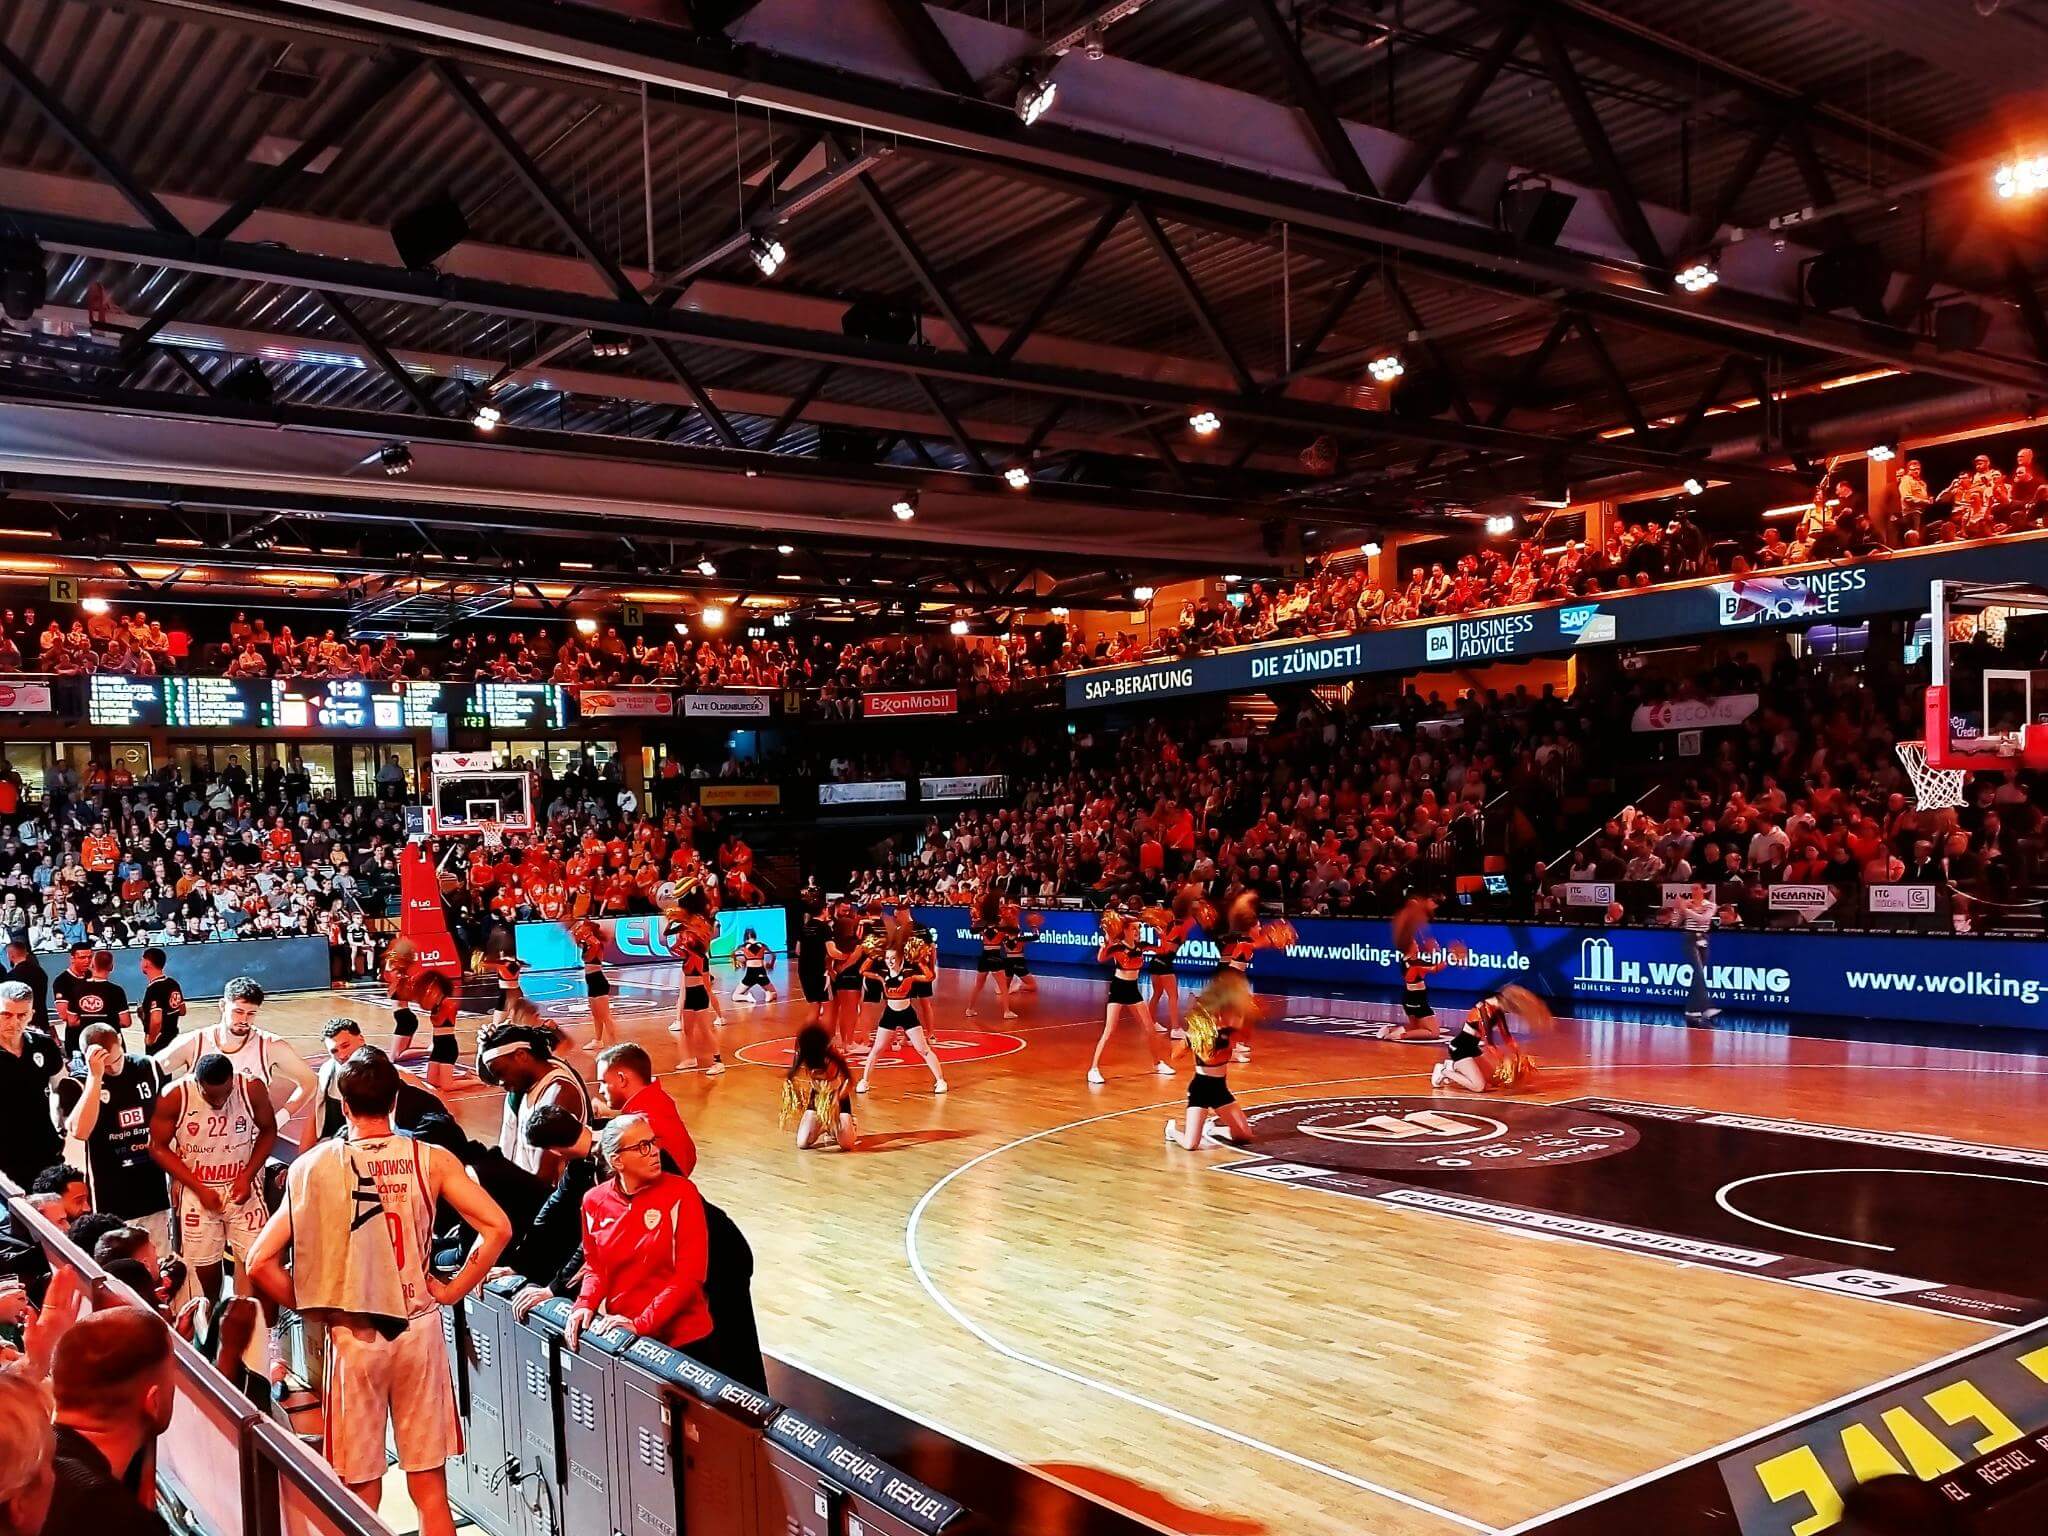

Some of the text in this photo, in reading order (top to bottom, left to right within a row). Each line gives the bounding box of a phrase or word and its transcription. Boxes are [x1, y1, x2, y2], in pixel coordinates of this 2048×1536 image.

[56, 580, 72, 599] R
[627, 608, 639, 624] R
[1560, 610, 1590, 628] SAP
[1460, 614, 1534, 640] BUSINESS
[1431, 637, 1448, 651] BA
[1460, 635, 1514, 657] ADVICE
[1251, 643, 1361, 678] DIE ZÜNDET!
[1085, 668, 1193, 700] SAP-BERATUNG
[871, 695, 949, 713] ExxonMobil
[1771, 892, 1826, 901] NEMANN
[1874, 889, 1889, 898] ITG
[420, 950, 440, 961] LzO
[1573, 982, 1616, 992] MÜHLEN-
[1621, 986, 1641, 994] UND
[1733, 992, 1756, 1001] SEIT
[1763, 994, 1790, 1004] 1878
[1846, 971, 2048, 1004] www.wolking-
[136, 1081, 152, 1100] 13
[122, 1110, 141, 1125] DB
[207, 1115, 228, 1138] 22
[1945, 1144, 2005, 1158] AUF
[1267, 1165, 1304, 1176] GS
[245, 1207, 266, 1232] 22
[1394, 1192, 1759, 1262] Feldarbeit vom Feinsten
[1836, 1275, 1900, 1291] GS
[1923, 1290, 2022, 1313] Gemeinsam
[676, 1360, 720, 1390] REFUEL
[718, 1383, 770, 1416] REFUEL
[774, 1414, 948, 1522] REFUEL REFUEL REFUEL
[1975, 1449, 2037, 1486] REFUEL
